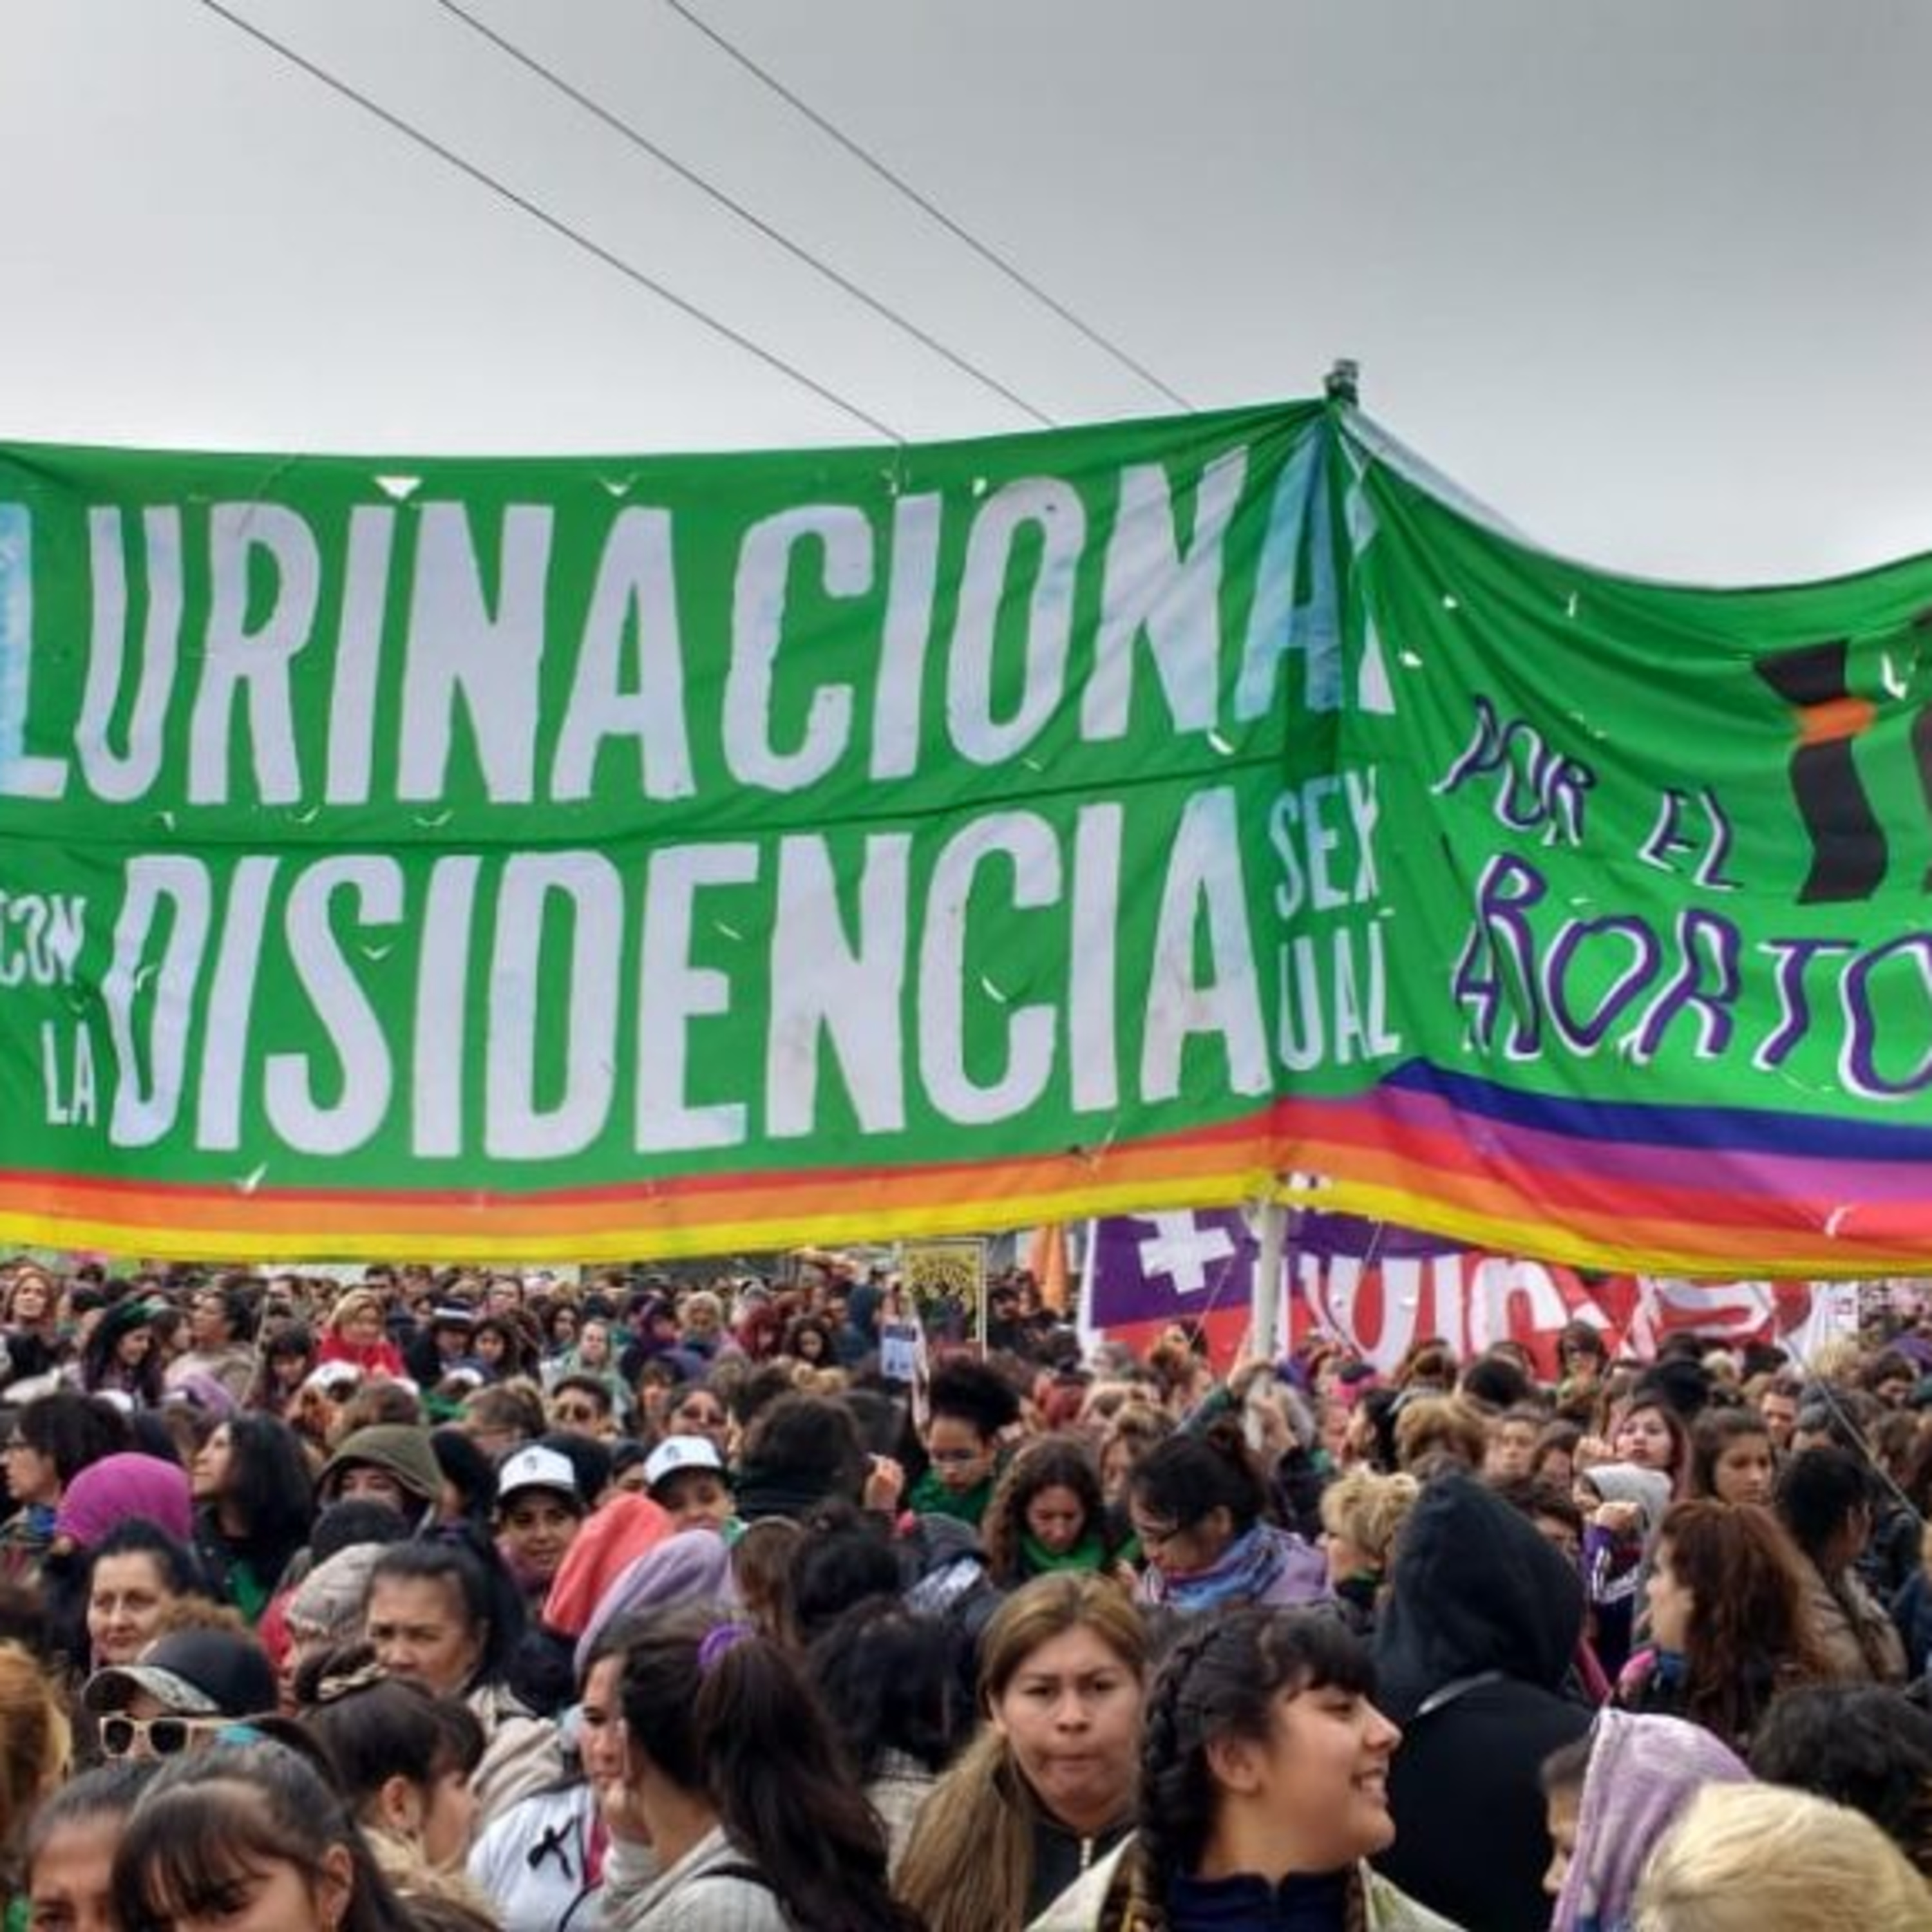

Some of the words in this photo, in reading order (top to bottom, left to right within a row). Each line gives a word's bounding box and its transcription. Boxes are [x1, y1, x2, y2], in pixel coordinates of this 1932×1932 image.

[1270, 764, 1379, 919] SEX
[1638, 787, 1744, 891] EL
[100, 786, 1274, 1159] DISIDENCIA
[1278, 921, 1401, 1072] UAL
[42, 1019, 96, 1128] LA
